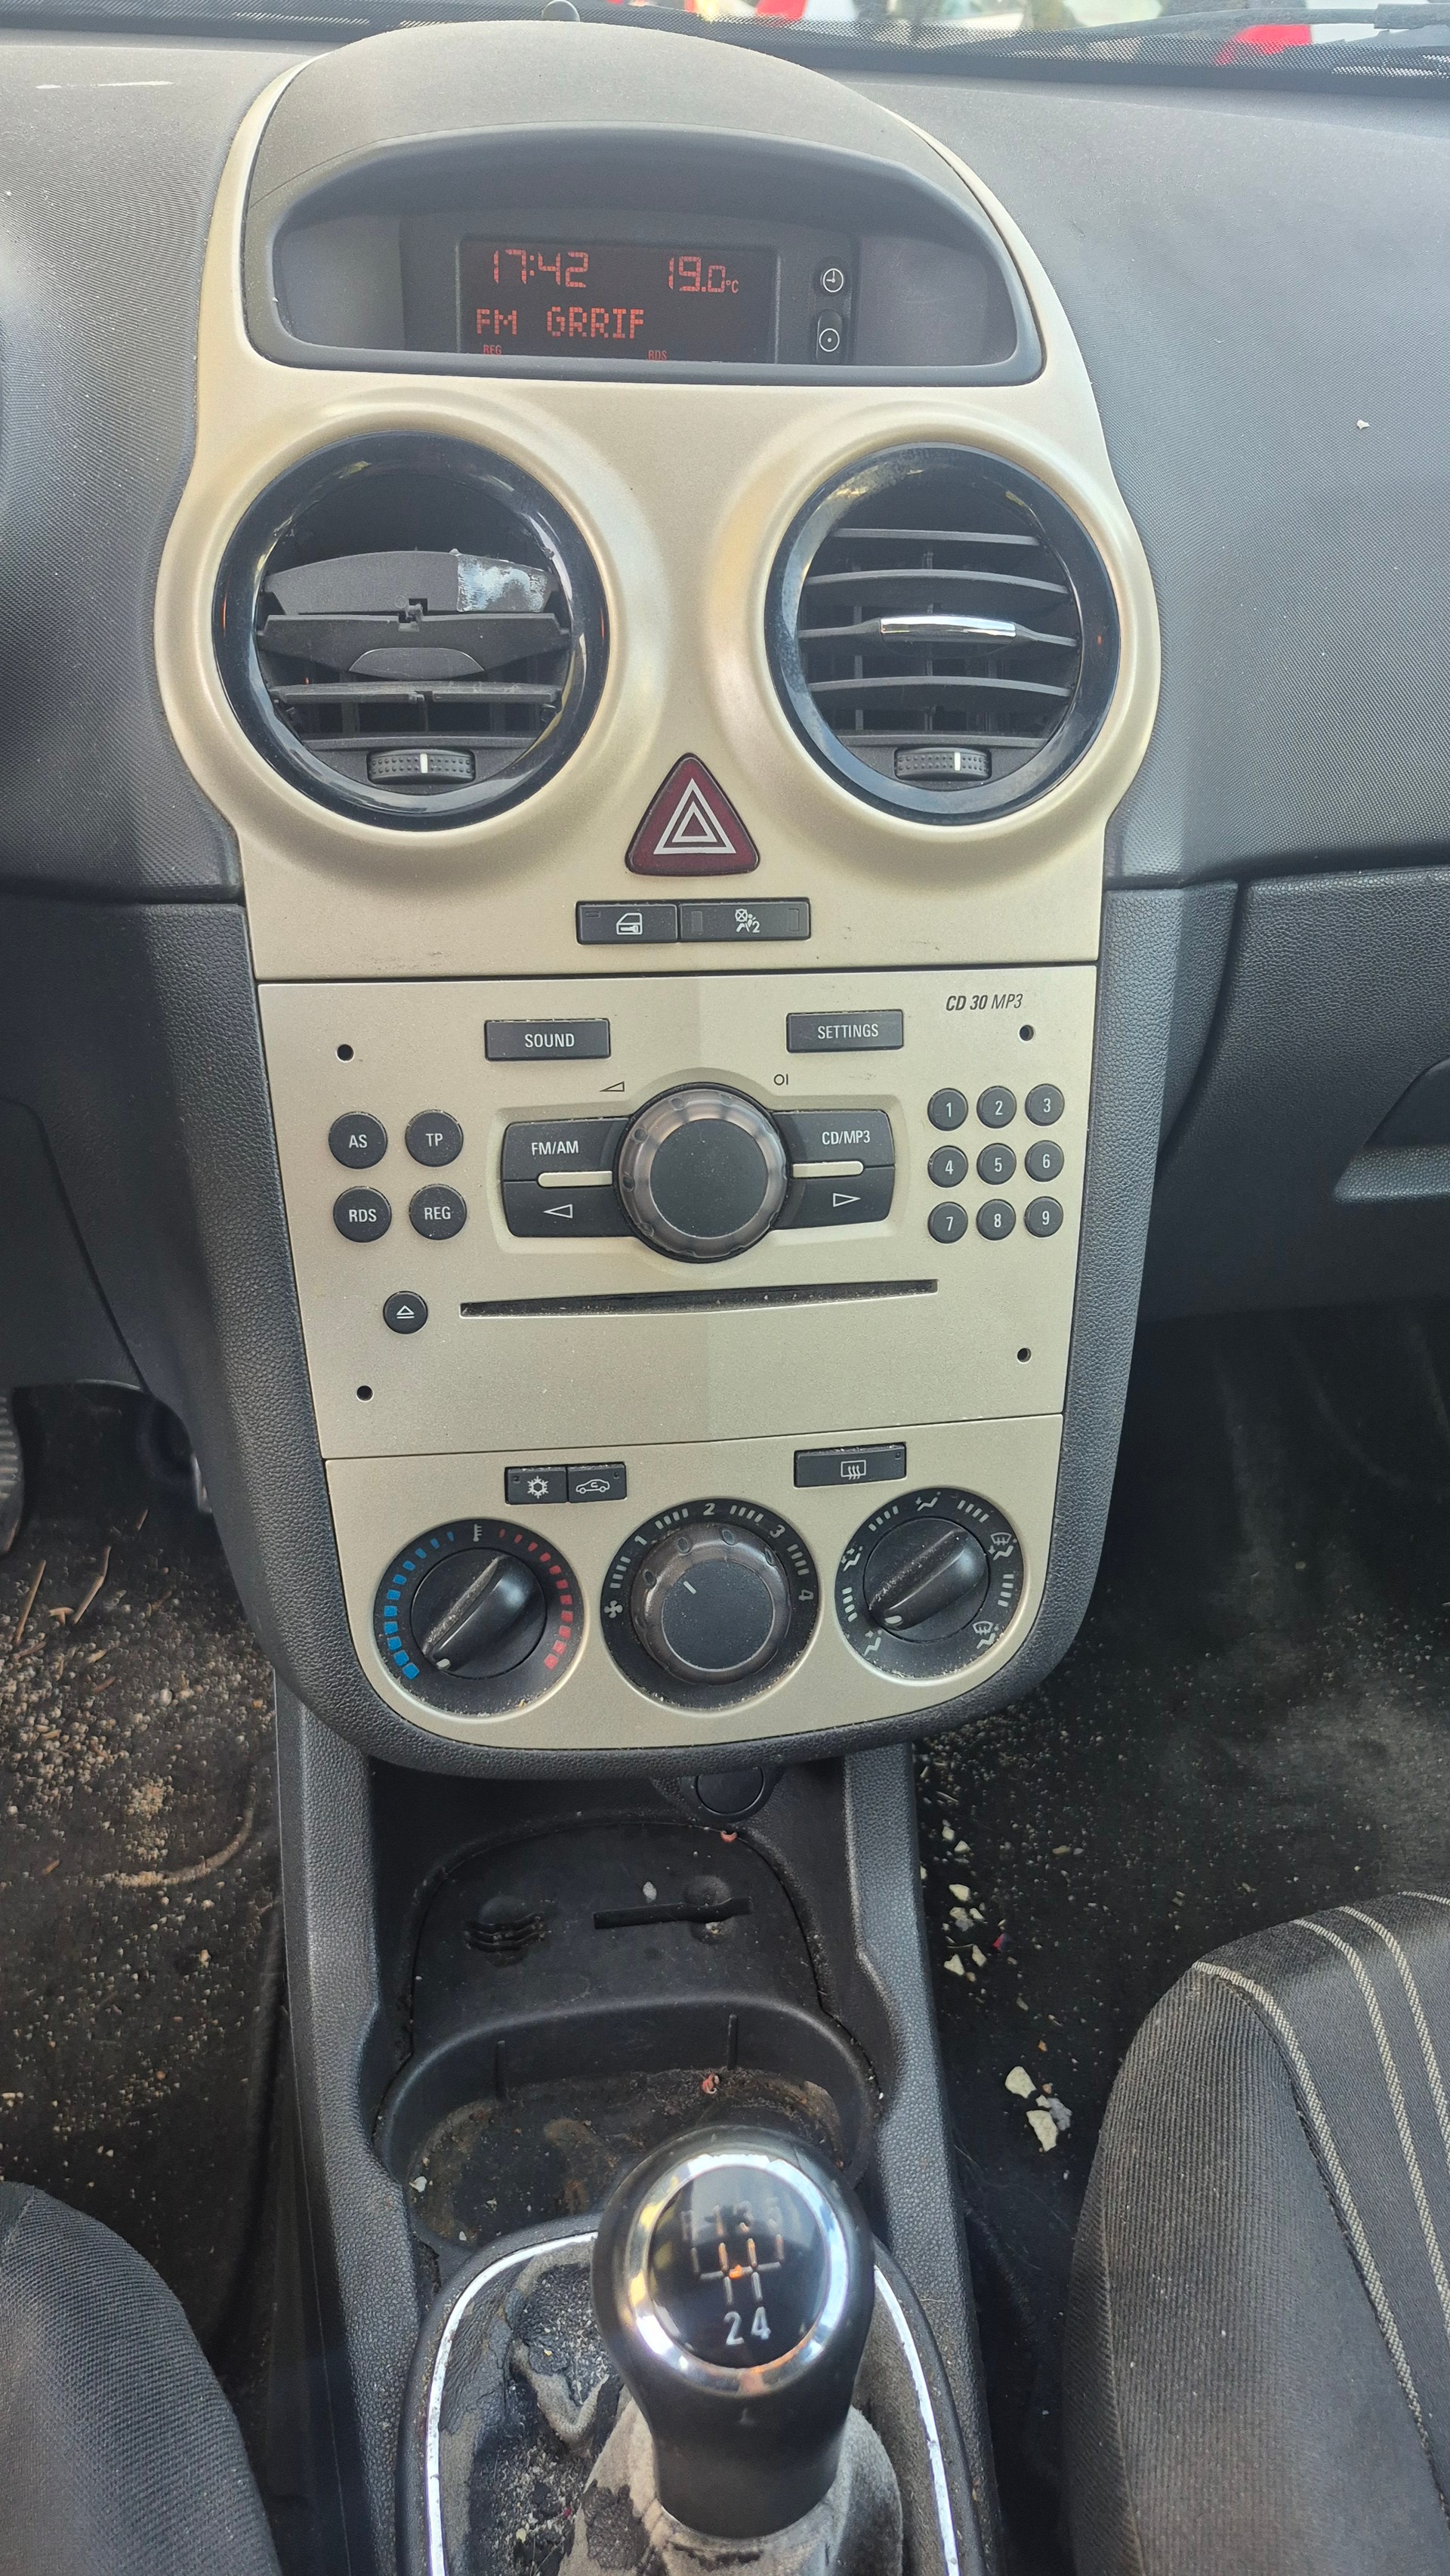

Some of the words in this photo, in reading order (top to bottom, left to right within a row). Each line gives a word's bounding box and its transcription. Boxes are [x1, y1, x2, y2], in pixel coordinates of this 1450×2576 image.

[493, 249, 589, 289] 17:42
[477, 308, 517, 335] FM
[547, 306, 644, 339] GRRIF
[946, 995, 967, 1012] CD
[969, 994, 988, 1011] 30
[991, 993, 1023, 1010] MP3
[817, 1024, 879, 1039] SETTINGS
[524, 1033, 575, 1049] SOUND
[945, 1102, 952, 1118] 1
[995, 1100, 1003, 1116] 2
[1043, 1098, 1051, 1113] 3
[348, 1134, 368, 1149] AS
[425, 1132, 444, 1147] TP
[822, 1130, 871, 1146] CD/MP3
[531, 1140, 579, 1157] FM/AM
[945, 1160, 954, 1175] 4
[994, 1157, 1002, 1172] 5
[1042, 1154, 1050, 1169] 6
[348, 1209, 377, 1223] RDS
[424, 1206, 451, 1221] REG
[993, 1213, 1001, 1229] 8
[1041, 1211, 1050, 1225] 9
[946, 1217, 954, 1231] 7
[703, 1503, 716, 1515] 2
[770, 1524, 785, 1538] 3
[634, 1535, 647, 1546] 1
[798, 1589, 814, 1601] 4
[723, 2311, 745, 2346] 2
[751, 2306, 771, 2340] 4
